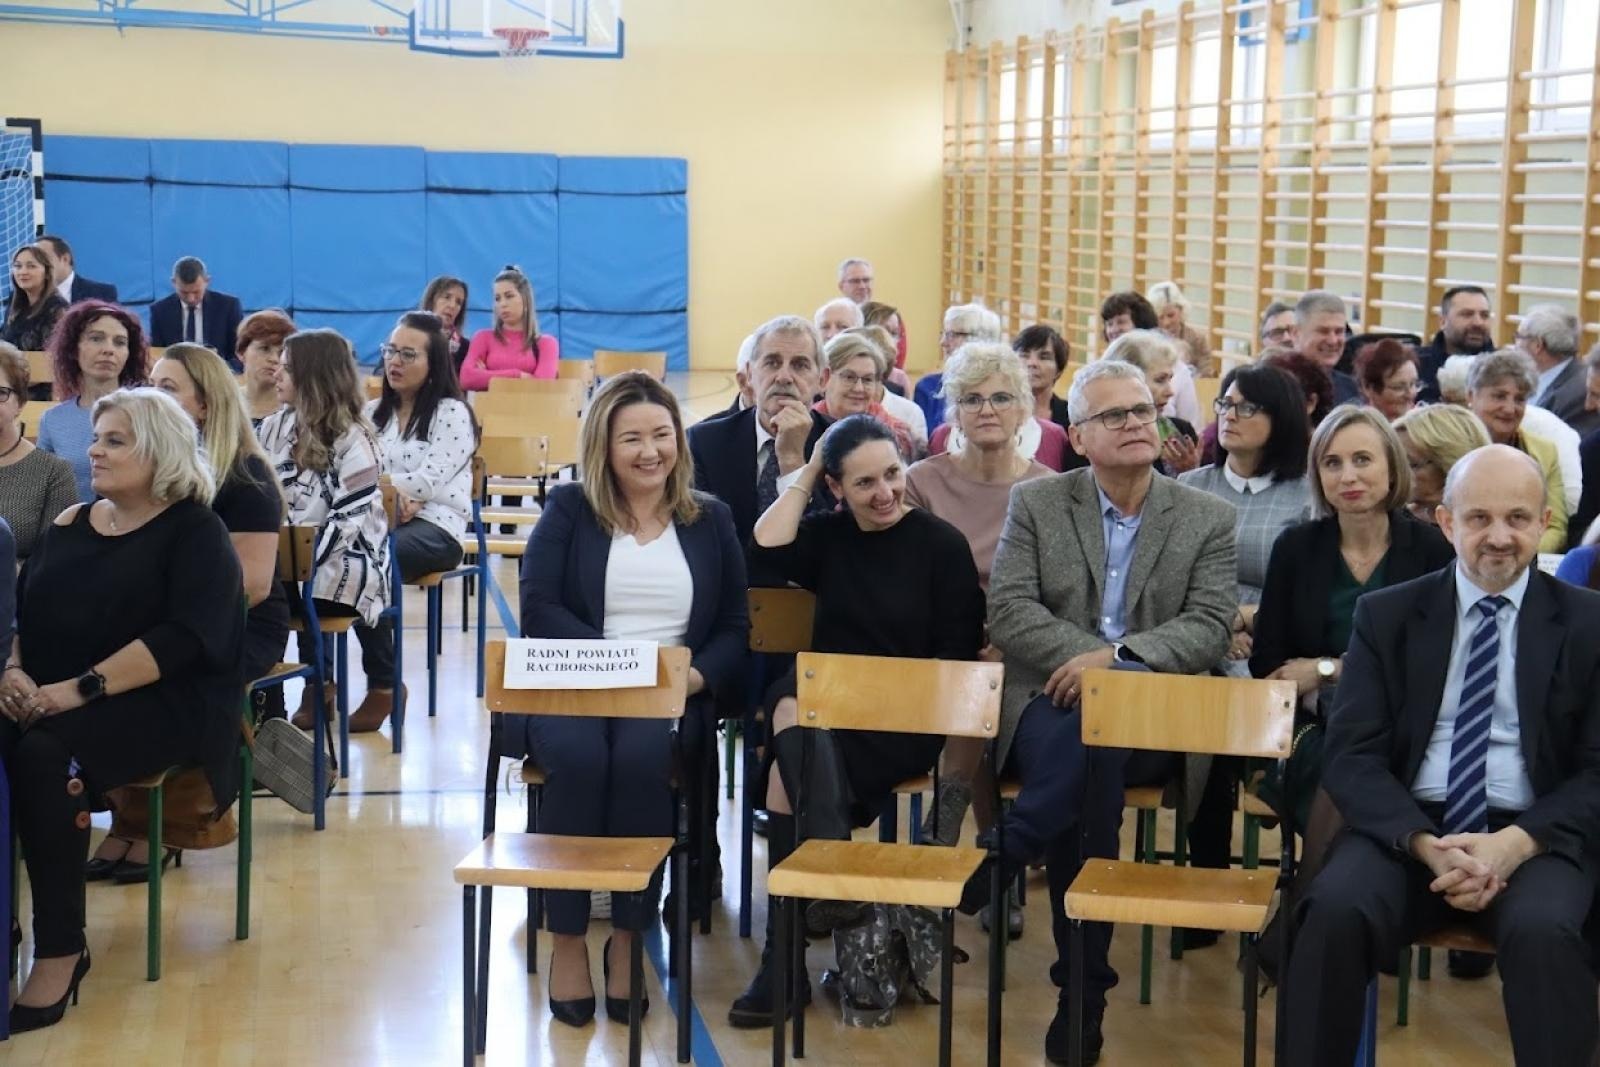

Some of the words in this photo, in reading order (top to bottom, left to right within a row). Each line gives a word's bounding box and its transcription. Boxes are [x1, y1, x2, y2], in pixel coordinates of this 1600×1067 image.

[527, 648, 569, 659] RADNI
[576, 648, 639, 659] POWIATU
[526, 661, 639, 672] RACIBORSKIEGO
